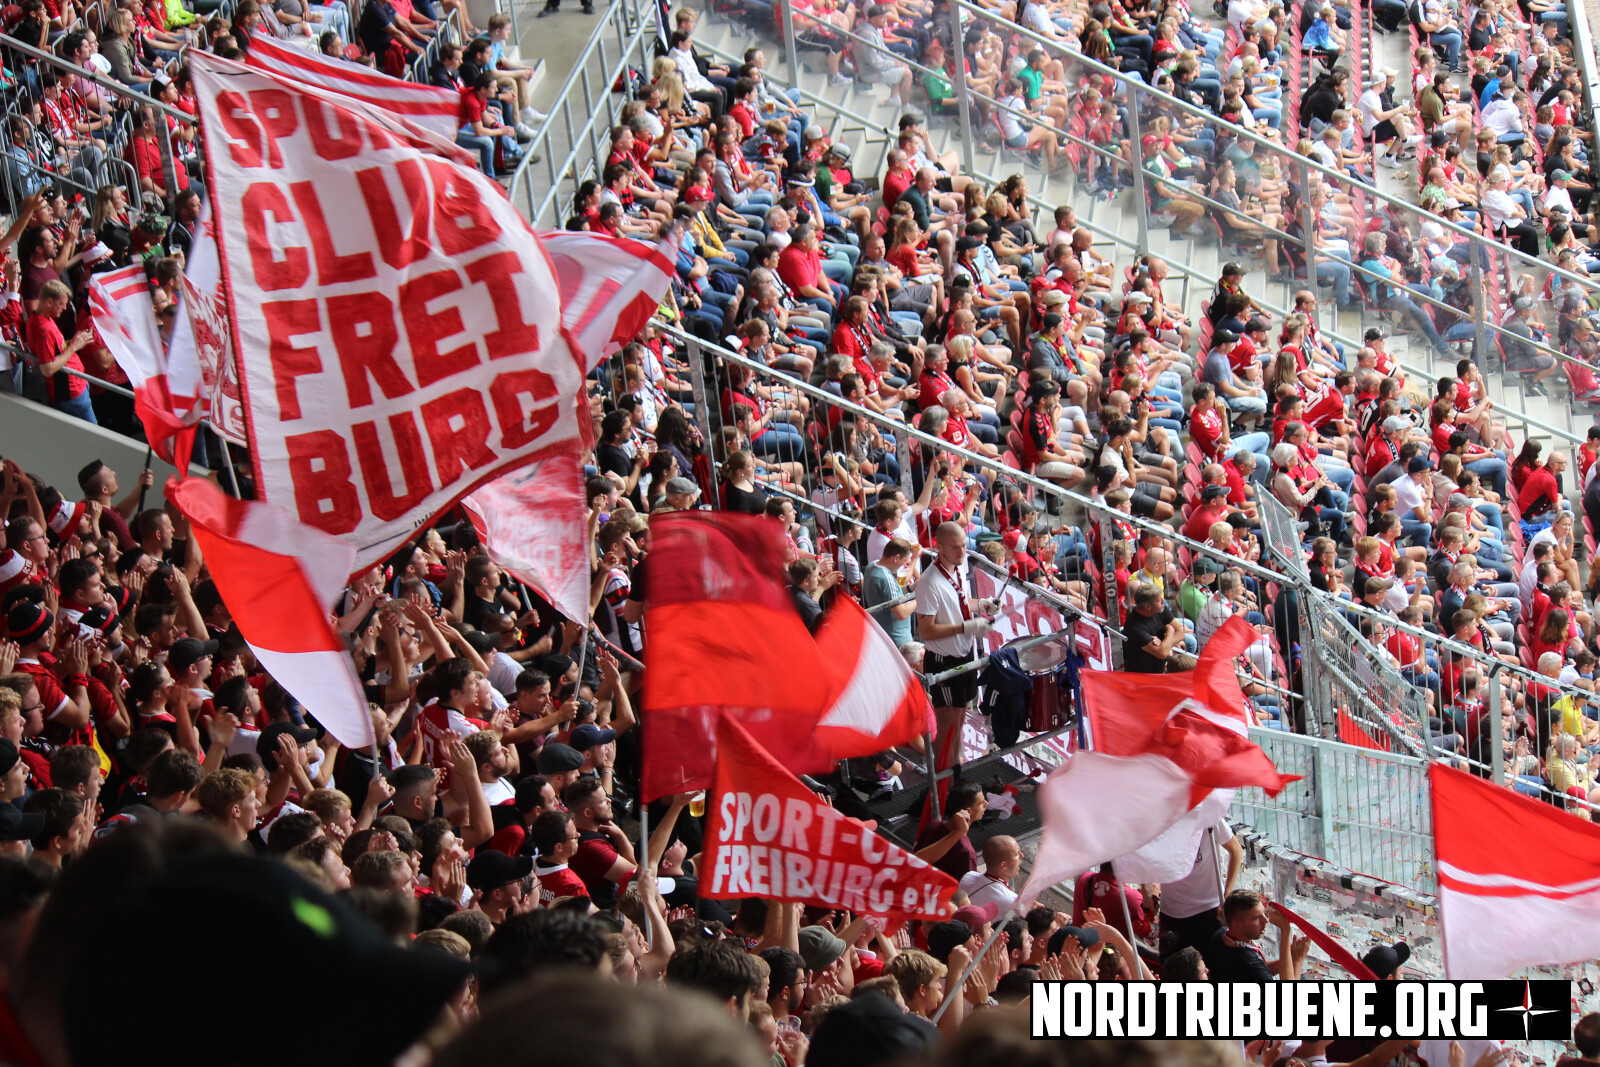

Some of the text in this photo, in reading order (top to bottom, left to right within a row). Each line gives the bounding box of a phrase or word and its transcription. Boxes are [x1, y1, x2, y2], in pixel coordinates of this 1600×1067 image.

[216, 88, 392, 170] SPO
[241, 156, 502, 292] CLUB
[261, 251, 541, 422] FREI
[285, 368, 560, 536] BURG
[710, 844, 948, 917] FREIBURG e.V.
[718, 791, 939, 872] SPORT-CL
